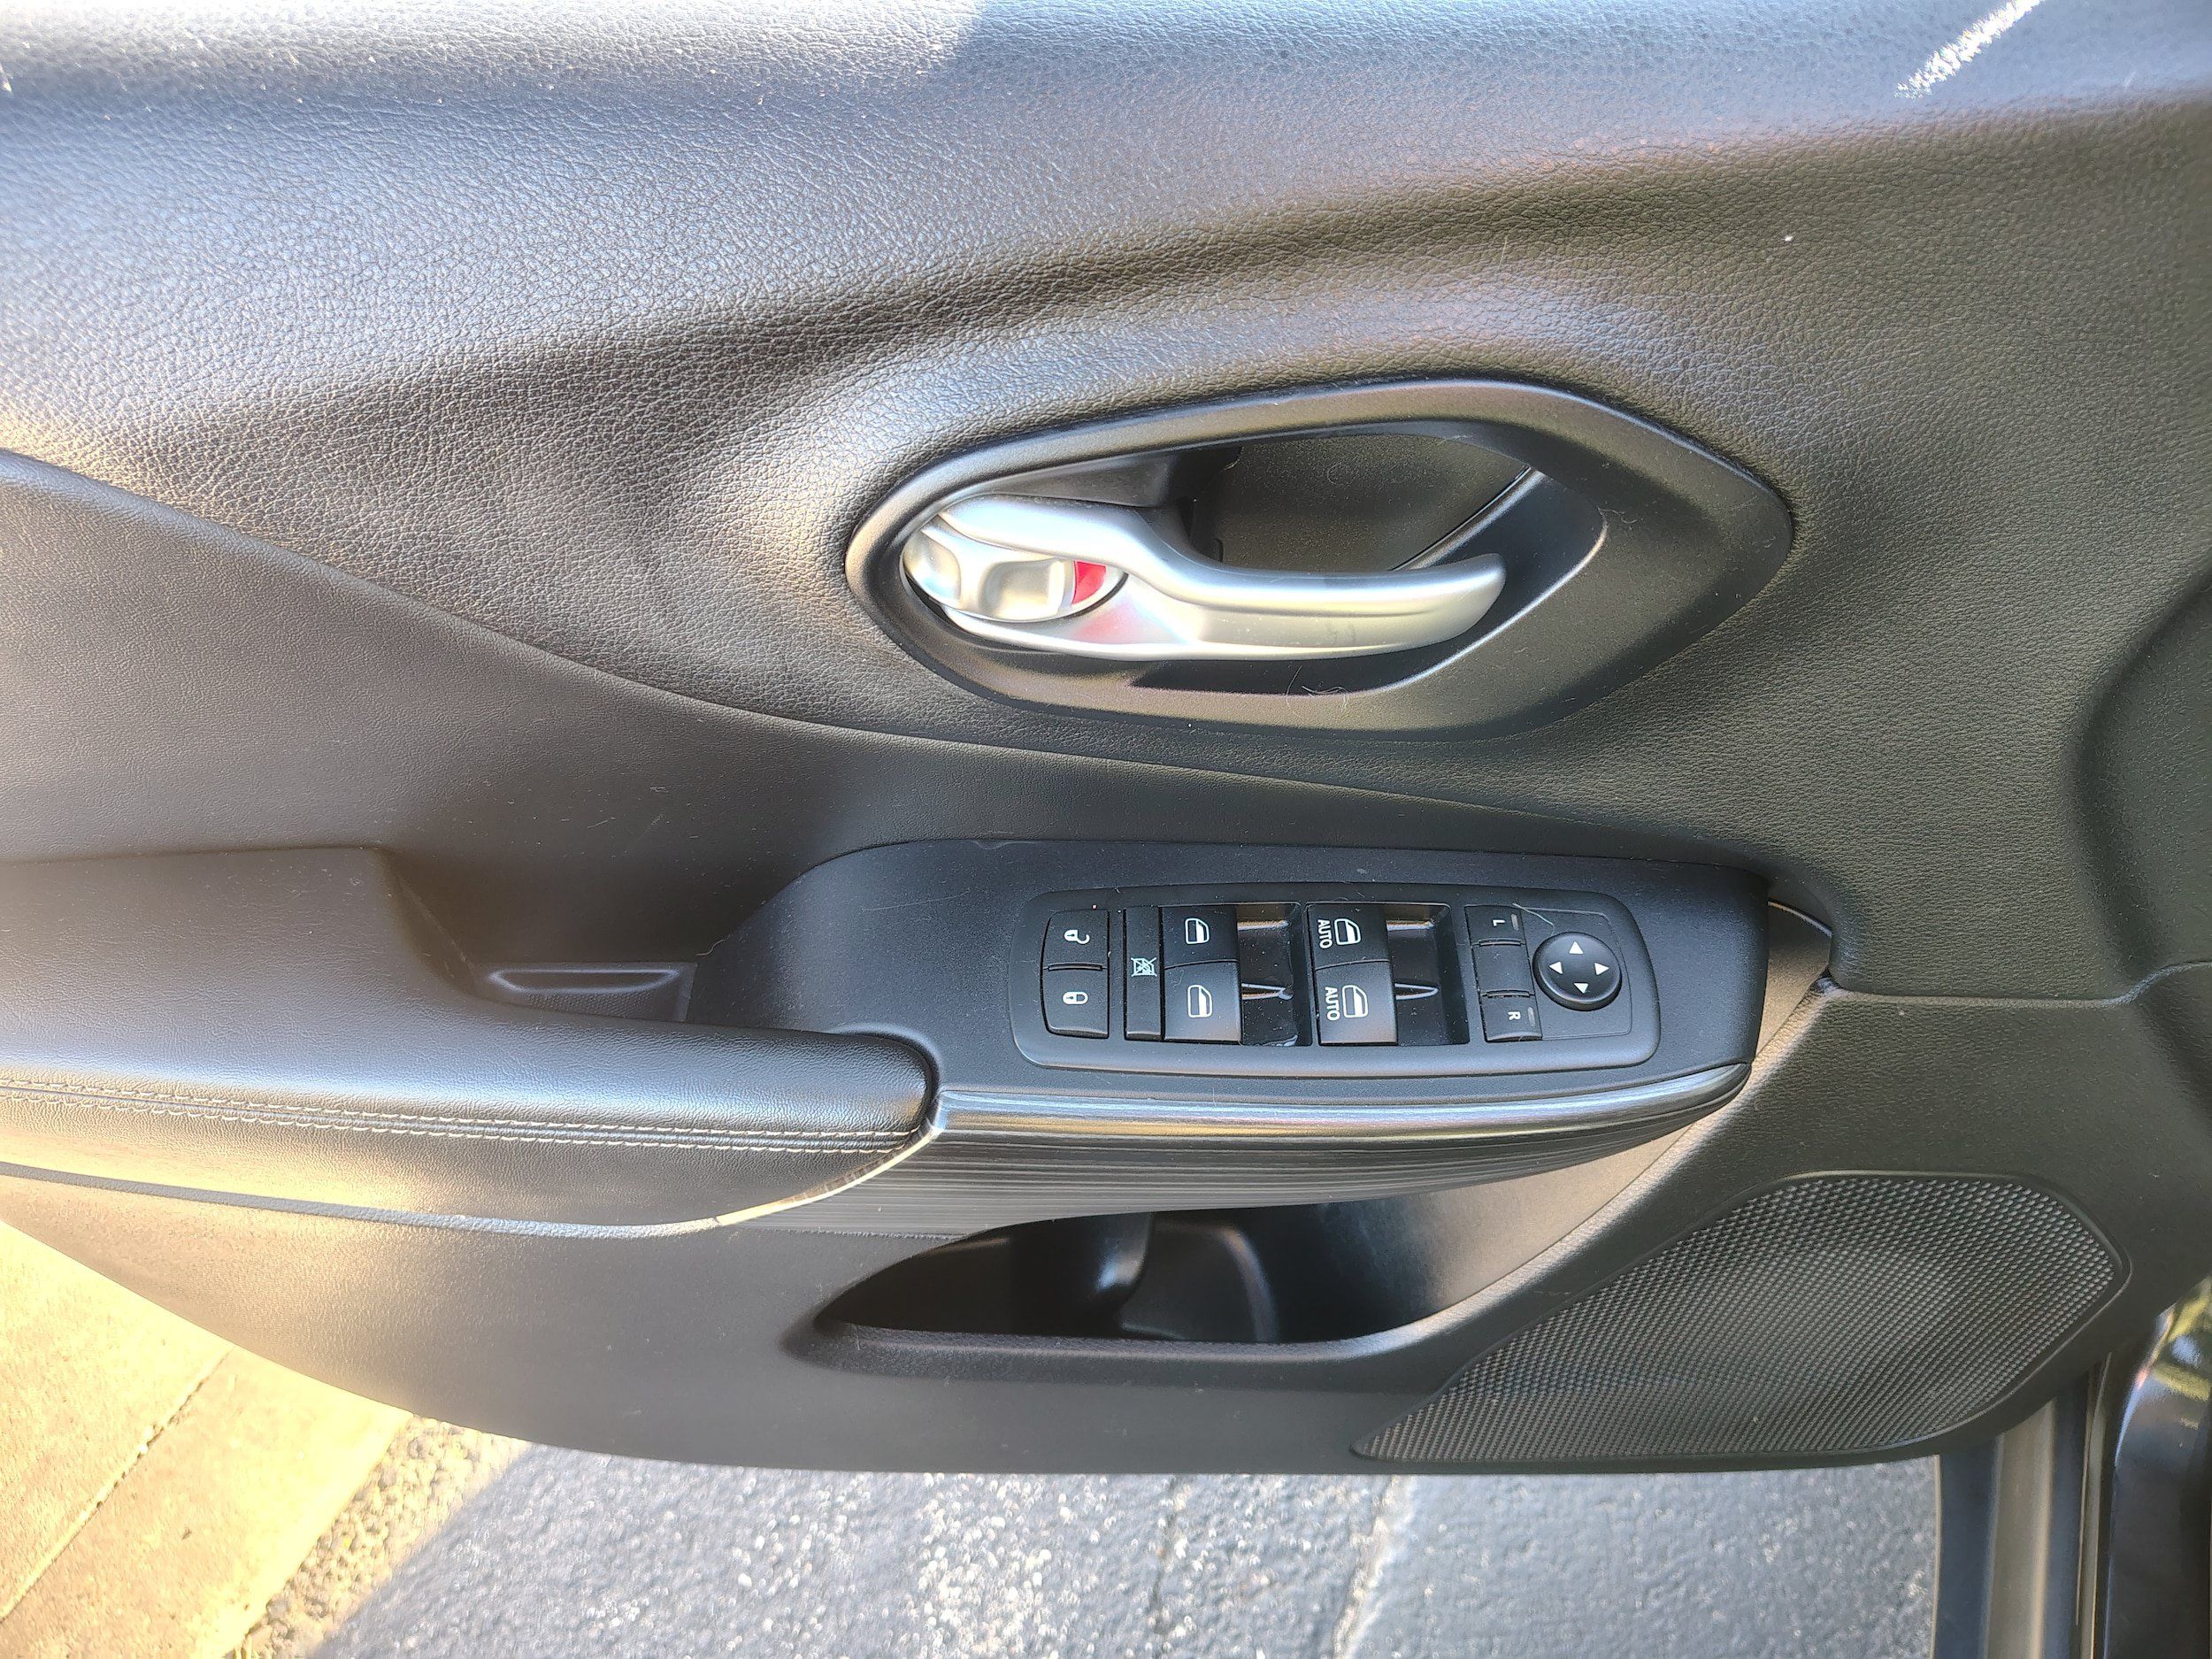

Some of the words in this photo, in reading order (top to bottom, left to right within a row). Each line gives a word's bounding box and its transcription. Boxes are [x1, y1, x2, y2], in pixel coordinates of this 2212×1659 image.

[1492, 918, 1505, 927] L
[1317, 918, 1333, 949] AUTO
[1325, 986, 1340, 1021] AUTO
[1507, 1010, 1521, 1021] R
